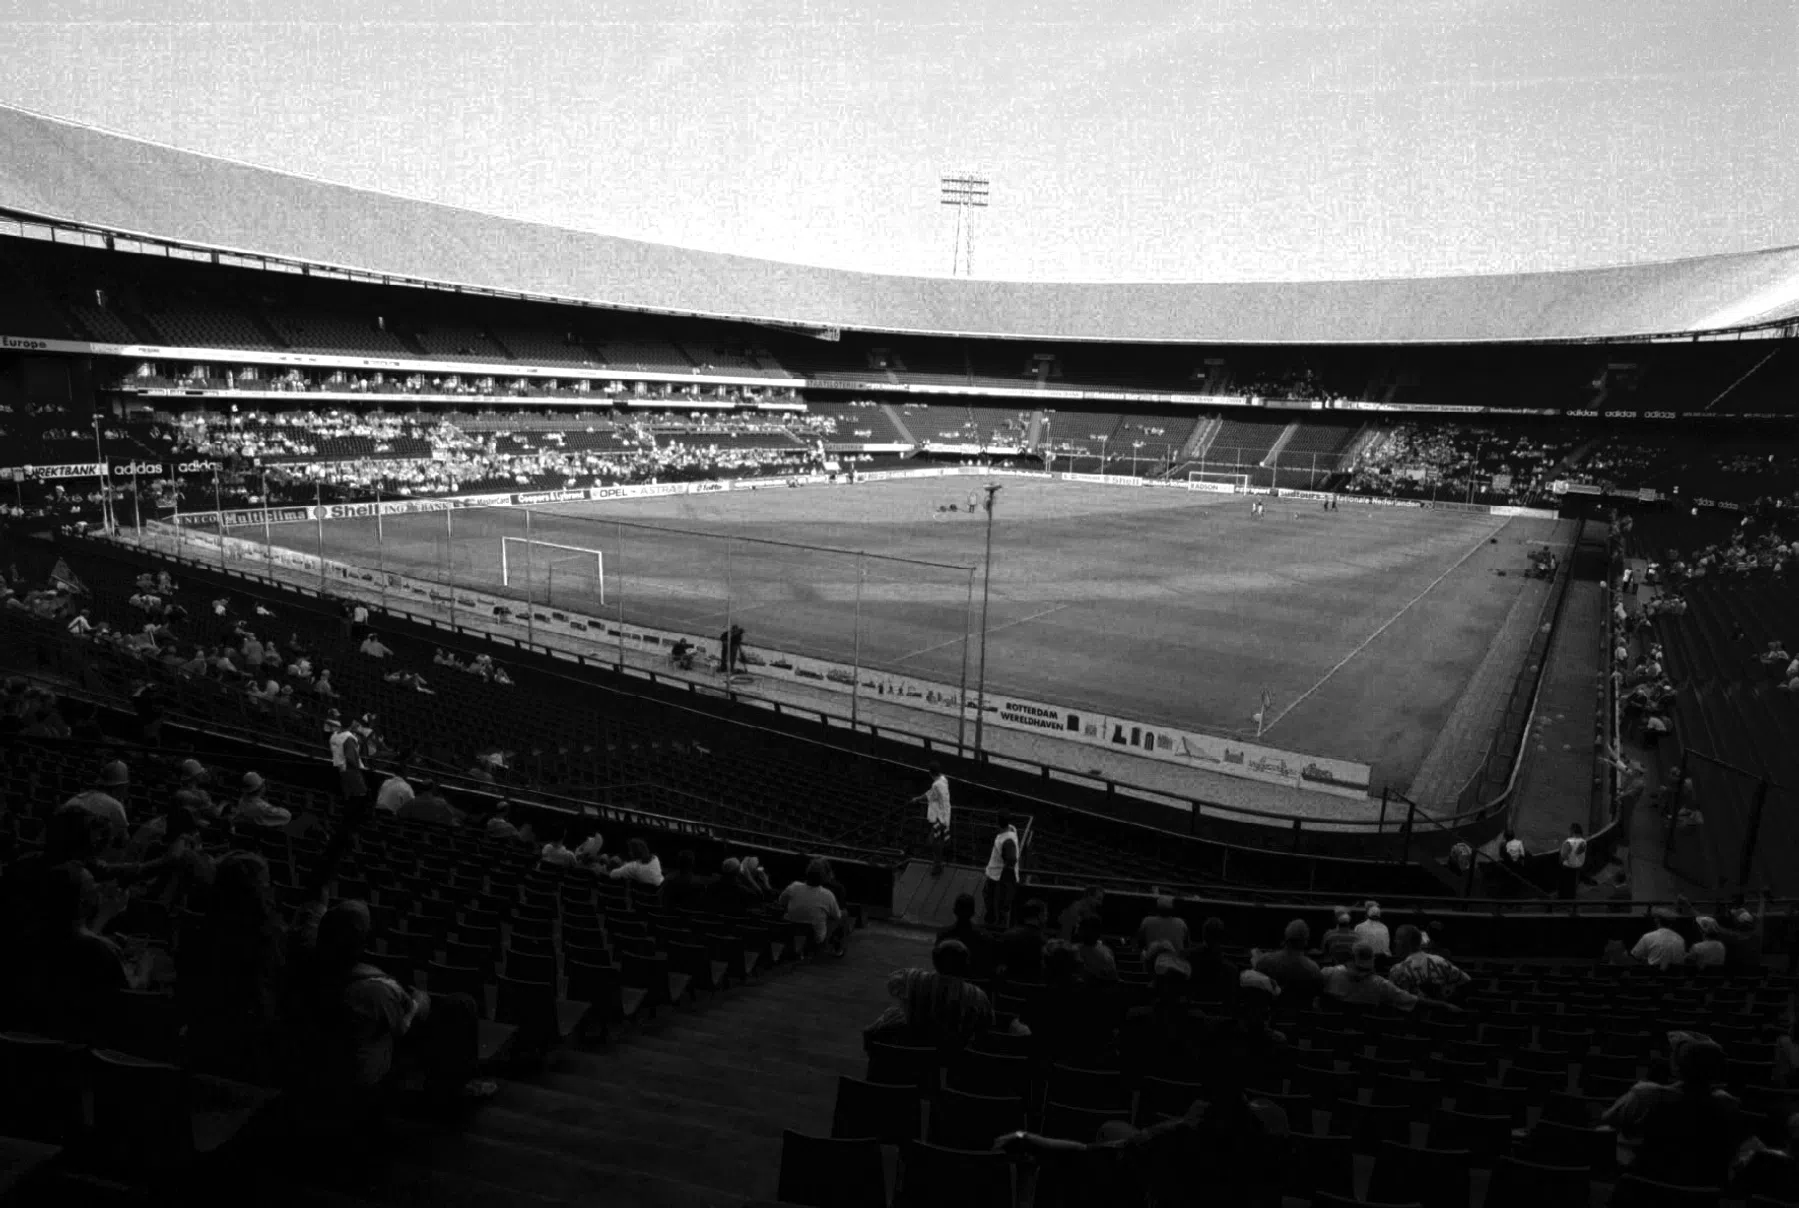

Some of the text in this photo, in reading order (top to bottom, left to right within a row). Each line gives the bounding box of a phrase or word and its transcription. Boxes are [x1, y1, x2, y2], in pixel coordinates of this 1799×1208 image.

[2, 335, 47, 350] Europe
[1567, 409, 1598, 417] adidas
[1644, 410, 1676, 419] adidas
[599, 489, 628, 498] OPEL
[331, 503, 379, 518] Shell
[1005, 702, 1058, 720] ROTTERDAM
[1000, 711, 1064, 731] WERELDHAVEN
